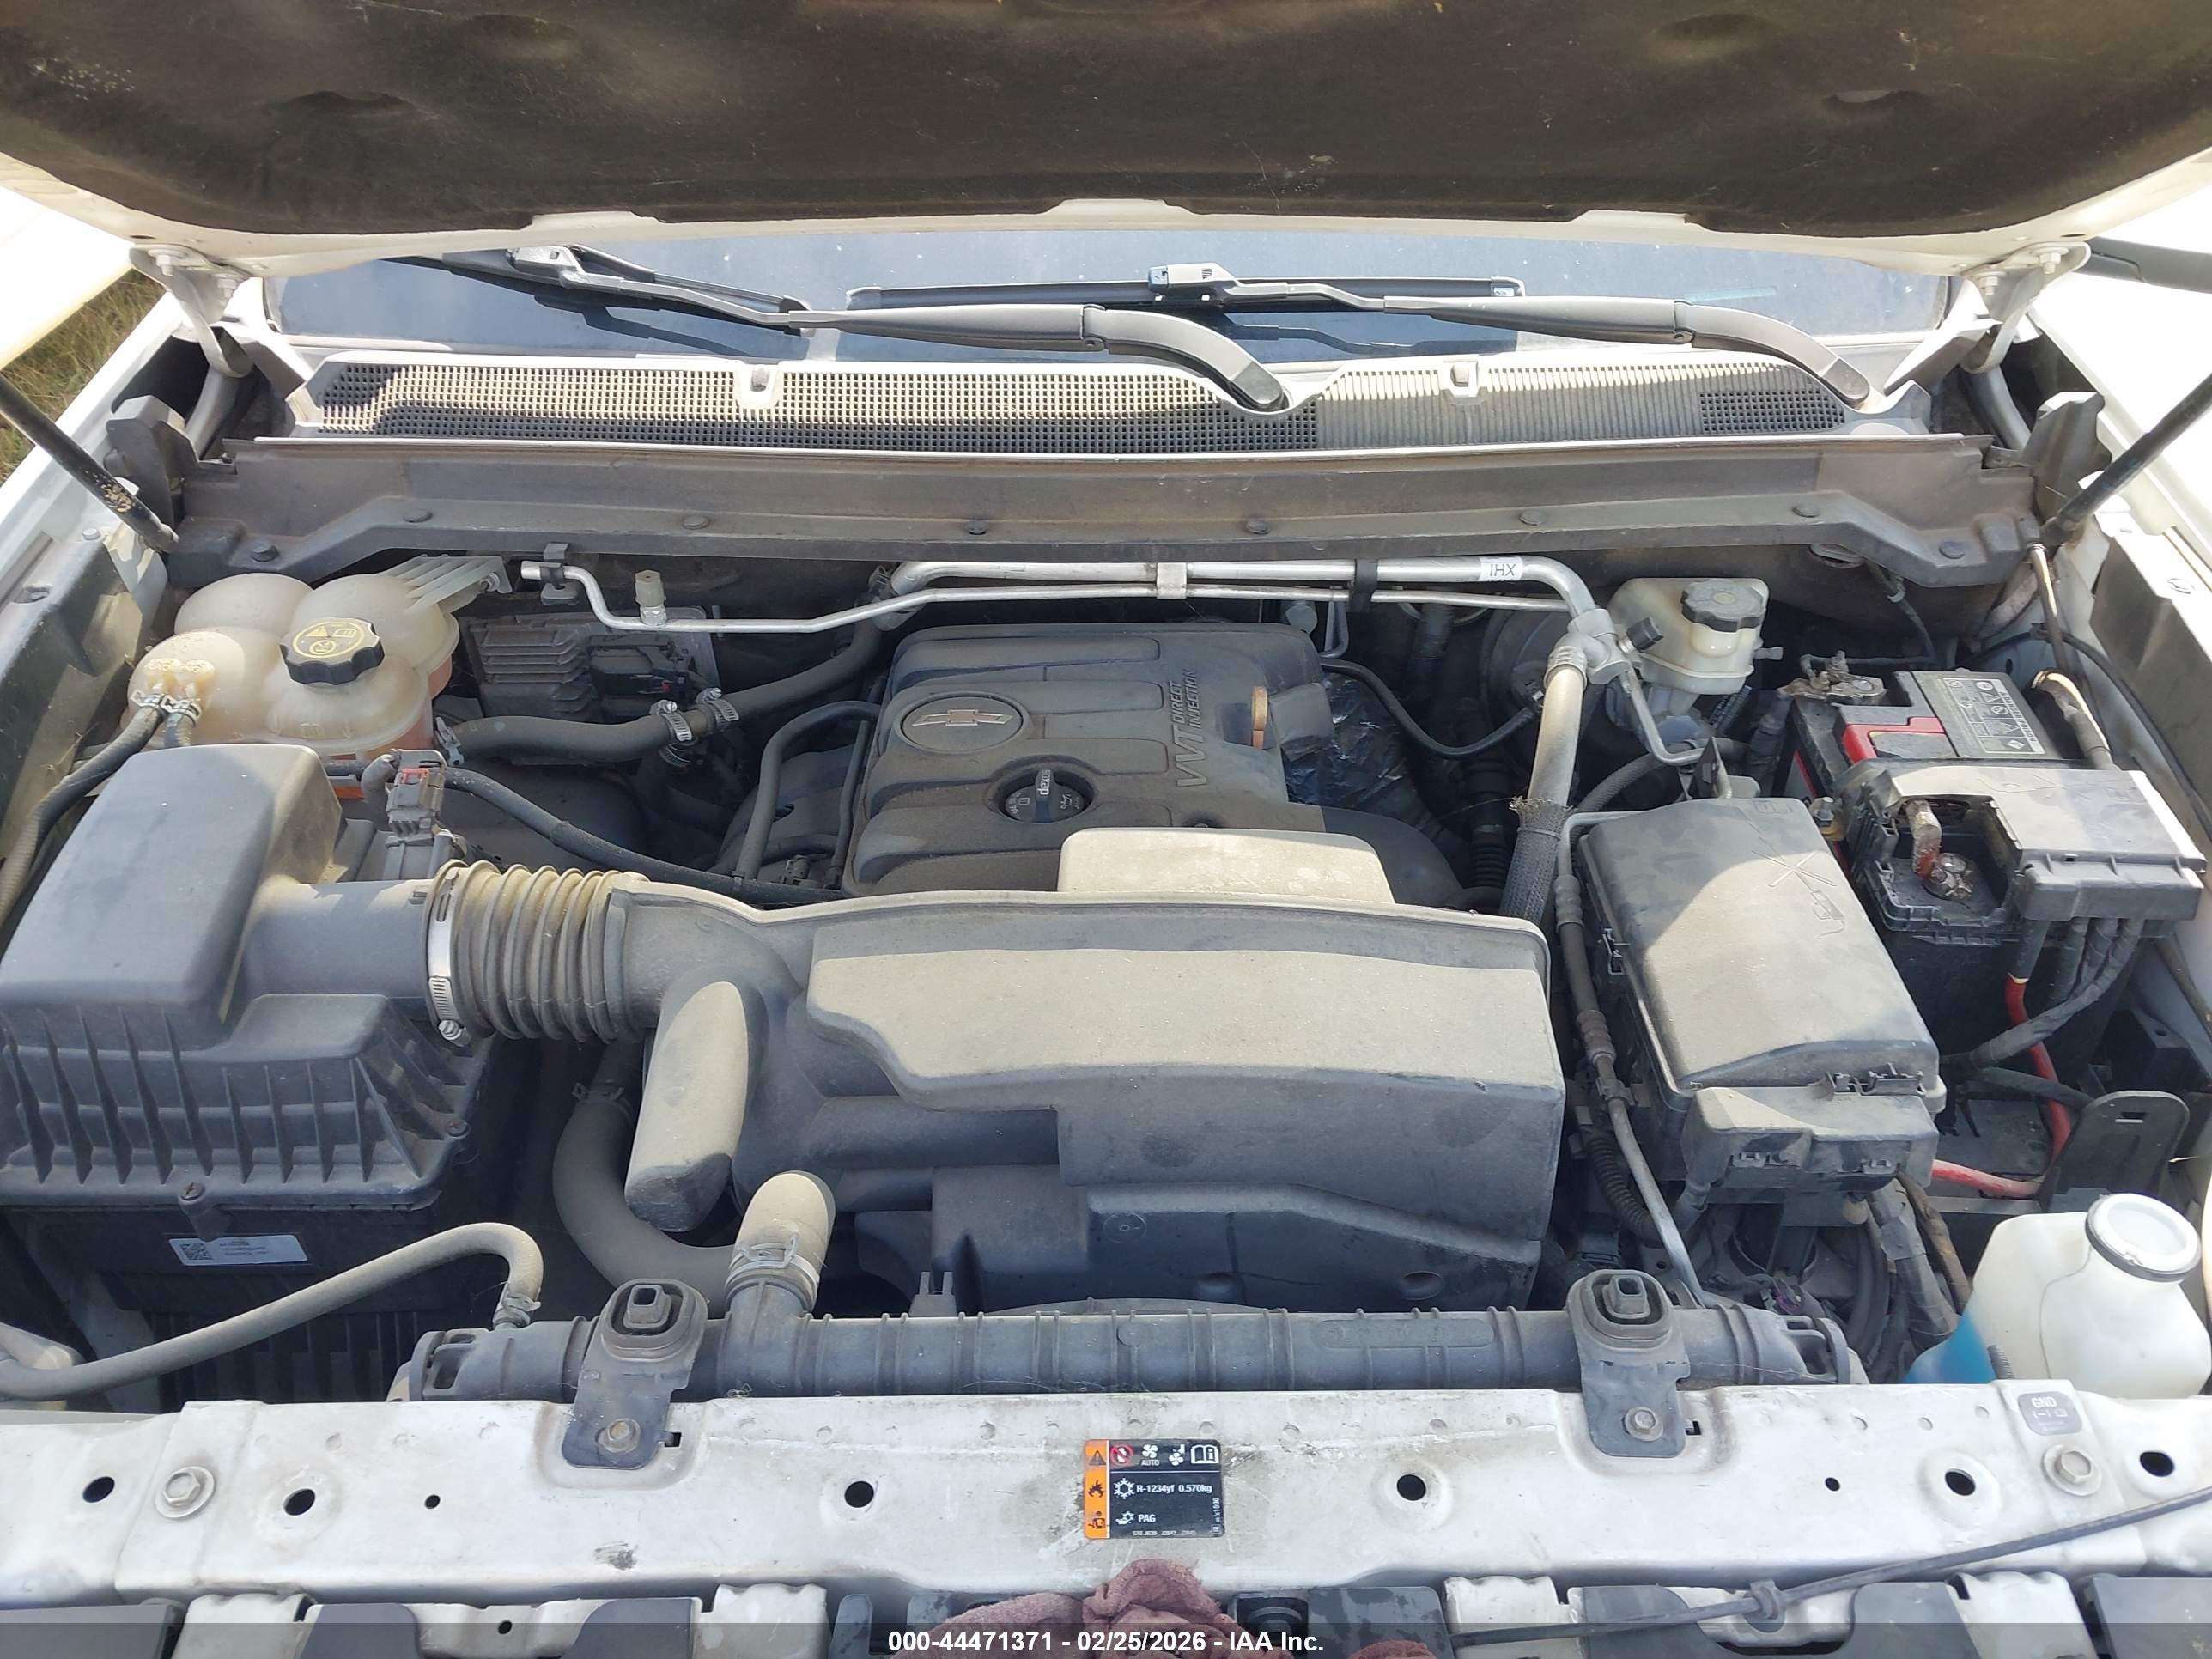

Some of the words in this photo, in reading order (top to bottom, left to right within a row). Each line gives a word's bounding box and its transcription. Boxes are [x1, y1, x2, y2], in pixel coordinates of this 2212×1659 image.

[1489, 563, 1516, 577] IHX
[1169, 679, 1186, 724] DIRECT
[1184, 668, 1202, 729] INJECTION
[1172, 723, 1208, 787] VVT
[1136, 1484, 1175, 1492] R-1234yf
[1178, 1484, 1212, 1493] 0.570kg
[1138, 1514, 1156, 1522] PAG
